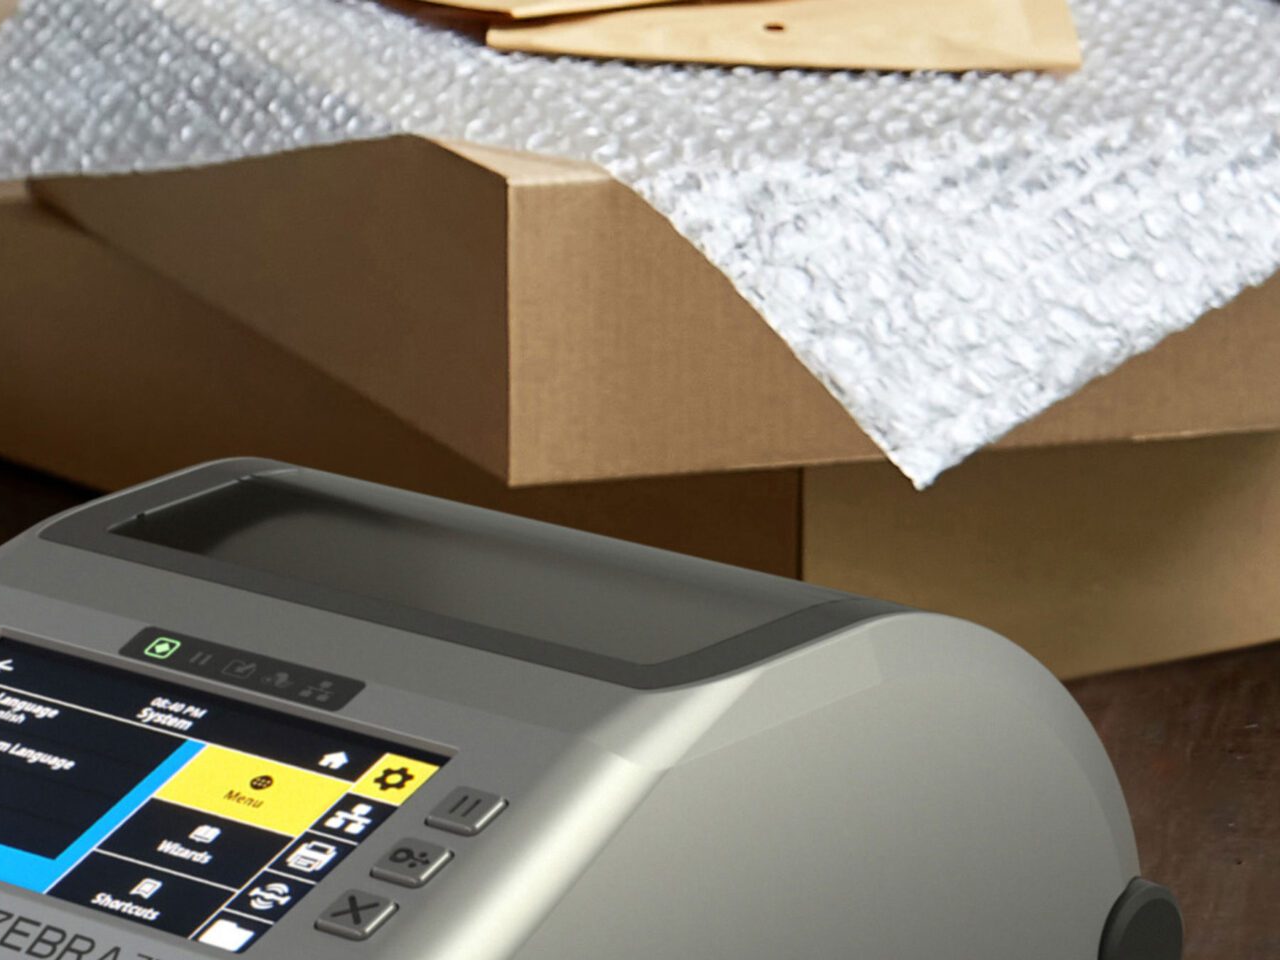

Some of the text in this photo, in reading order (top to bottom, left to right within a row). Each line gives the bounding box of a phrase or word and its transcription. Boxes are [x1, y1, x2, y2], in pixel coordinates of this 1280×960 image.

[136, 706, 193, 731] System
[182, 705, 208, 719] PM
[8, 743, 76, 770] Language
[223, 789, 264, 809] Menu
[156, 839, 213, 865] Wizards
[90, 892, 160, 921] Shortcuts
